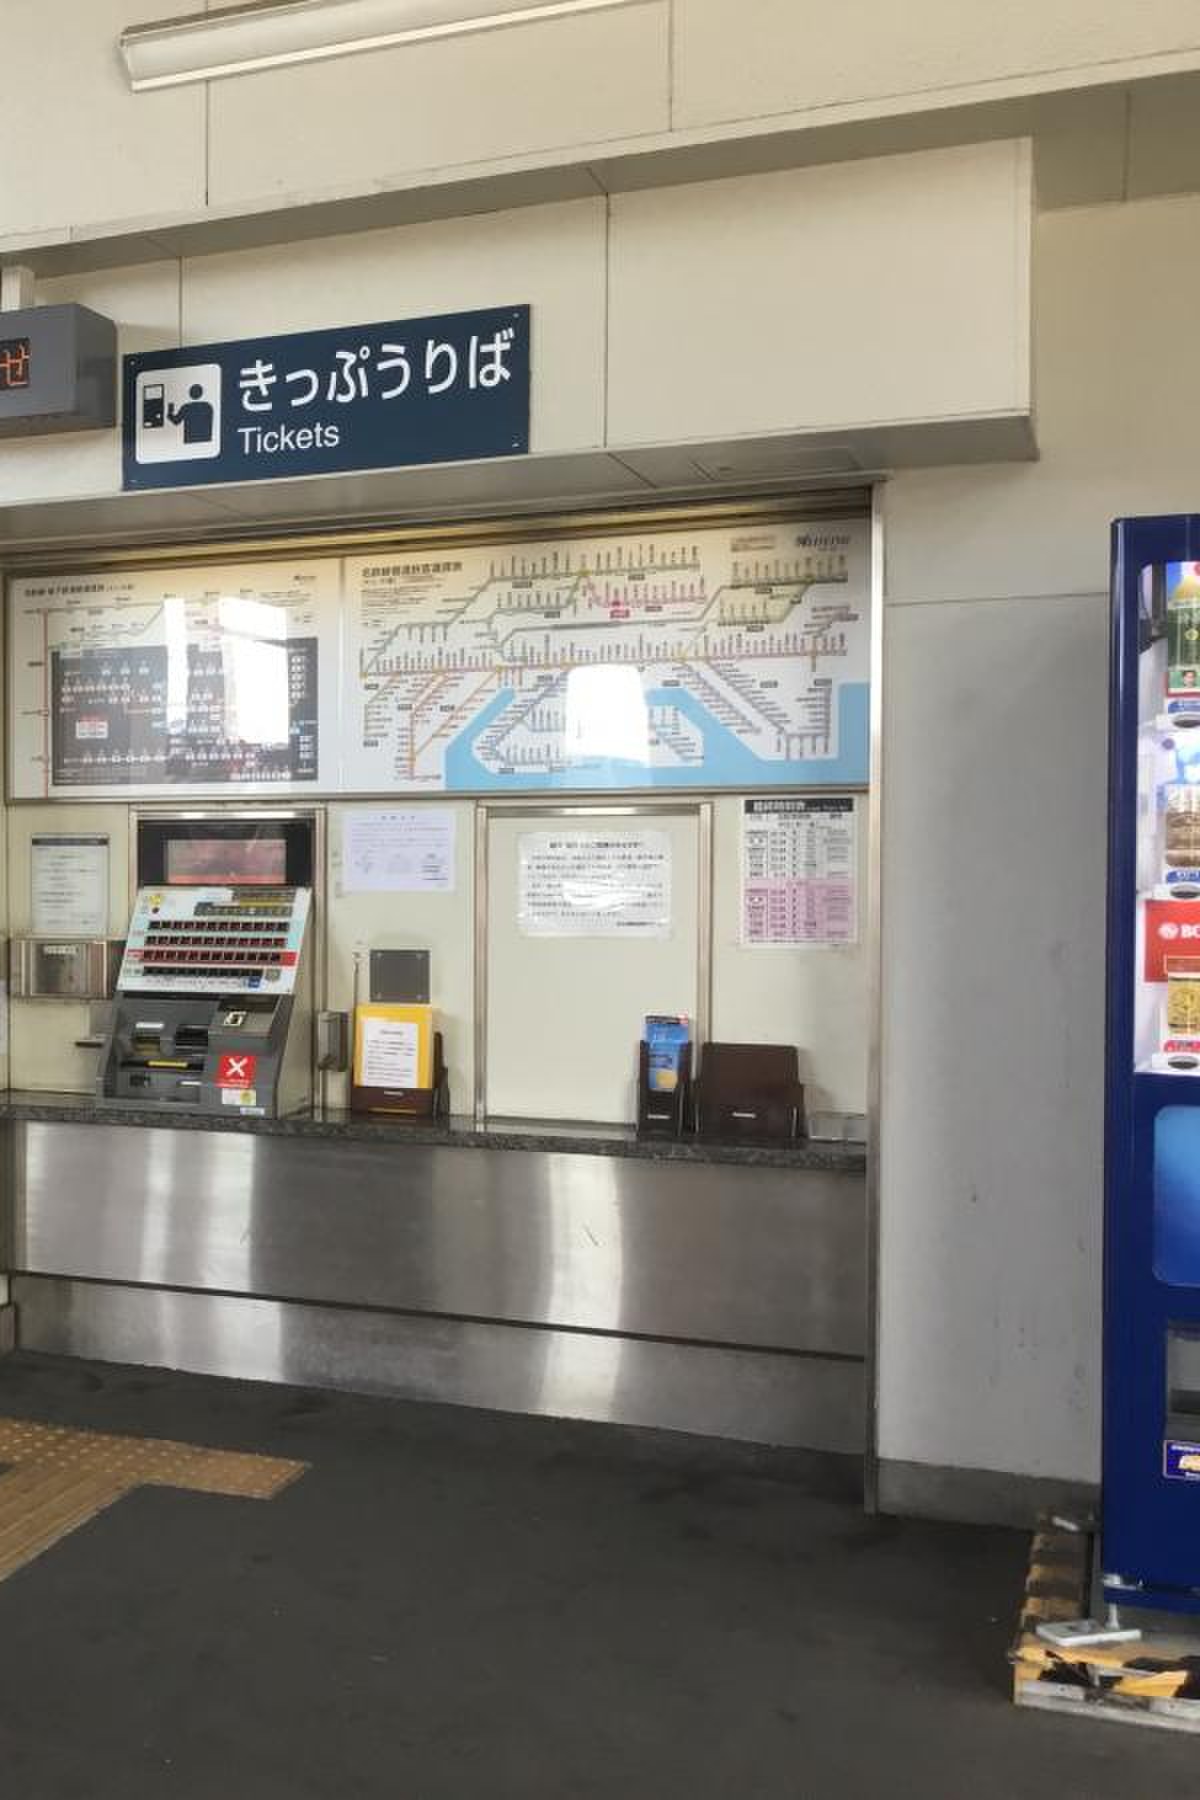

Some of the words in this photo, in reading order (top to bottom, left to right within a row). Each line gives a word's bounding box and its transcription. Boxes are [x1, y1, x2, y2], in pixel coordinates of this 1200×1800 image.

[238, 327, 515, 412] きっぷうりば
[238, 421, 340, 455] Tickets
